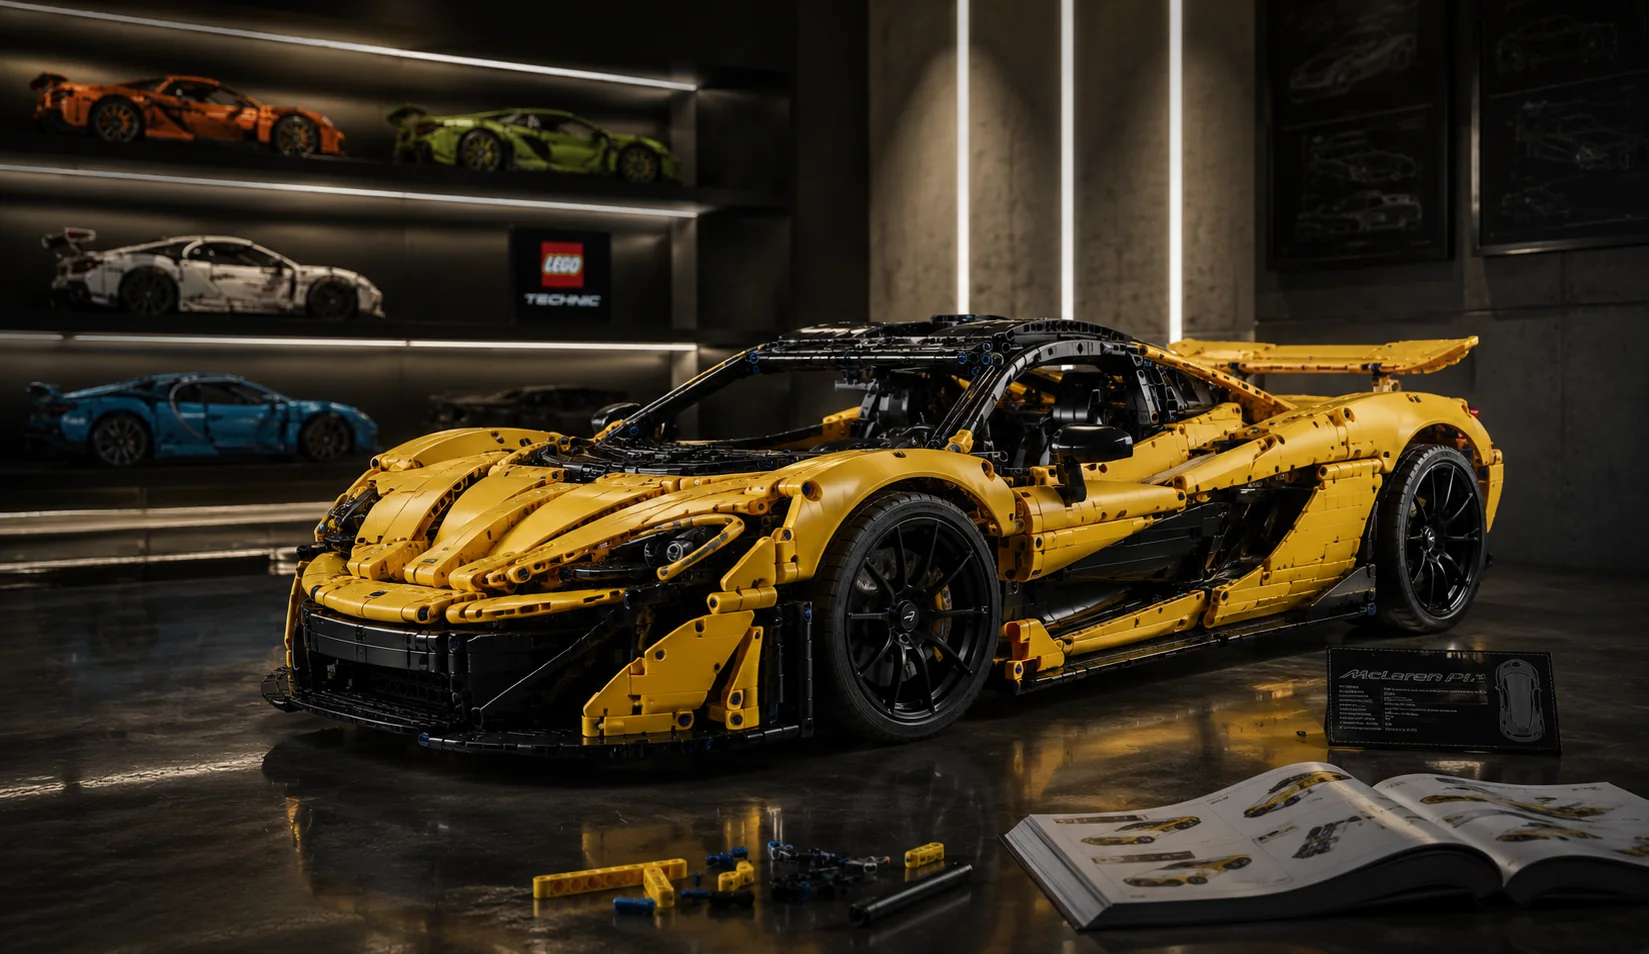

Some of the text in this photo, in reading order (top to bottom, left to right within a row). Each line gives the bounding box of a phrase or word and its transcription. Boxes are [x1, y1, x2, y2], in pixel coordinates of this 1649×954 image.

[543, 254, 582, 274] LEGO
[524, 293, 601, 307] TECHNIC
[1339, 669, 1443, 682] McLaren
